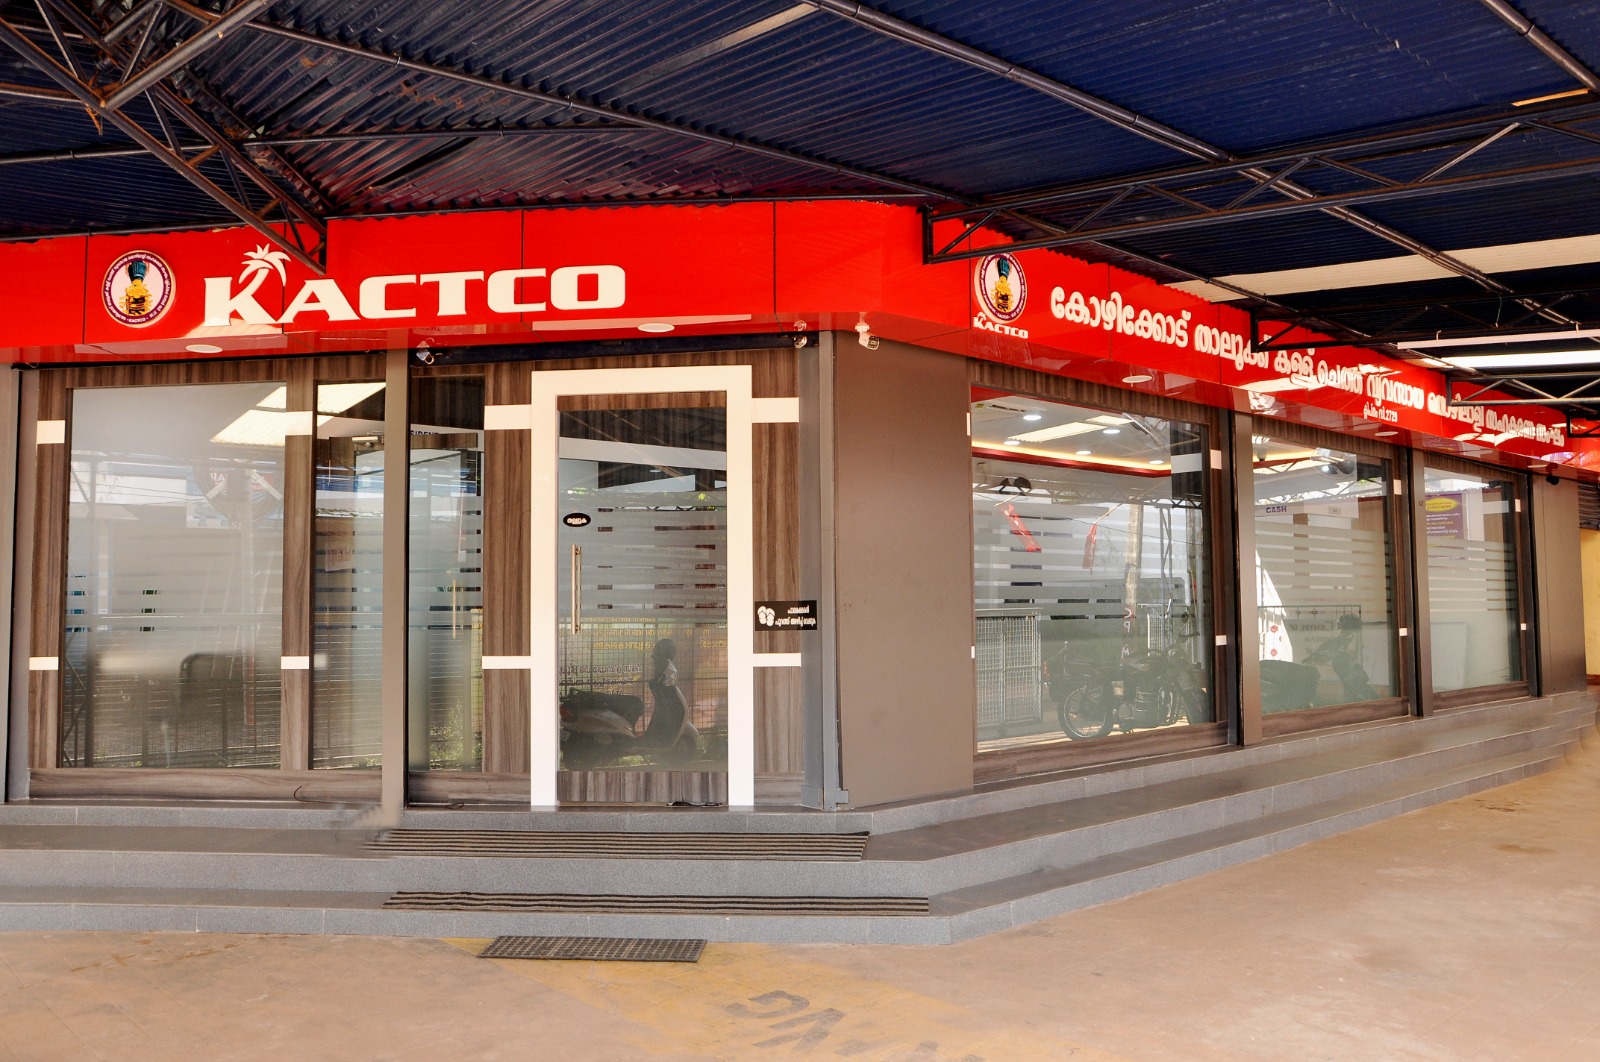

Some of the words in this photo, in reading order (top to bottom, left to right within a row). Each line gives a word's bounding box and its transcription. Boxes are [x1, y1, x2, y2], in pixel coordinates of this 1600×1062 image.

[203, 244, 626, 327] KACTCO
[973, 312, 1029, 339] KACTCO
[1050, 286, 1191, 348] കോഴിക്കോട്
